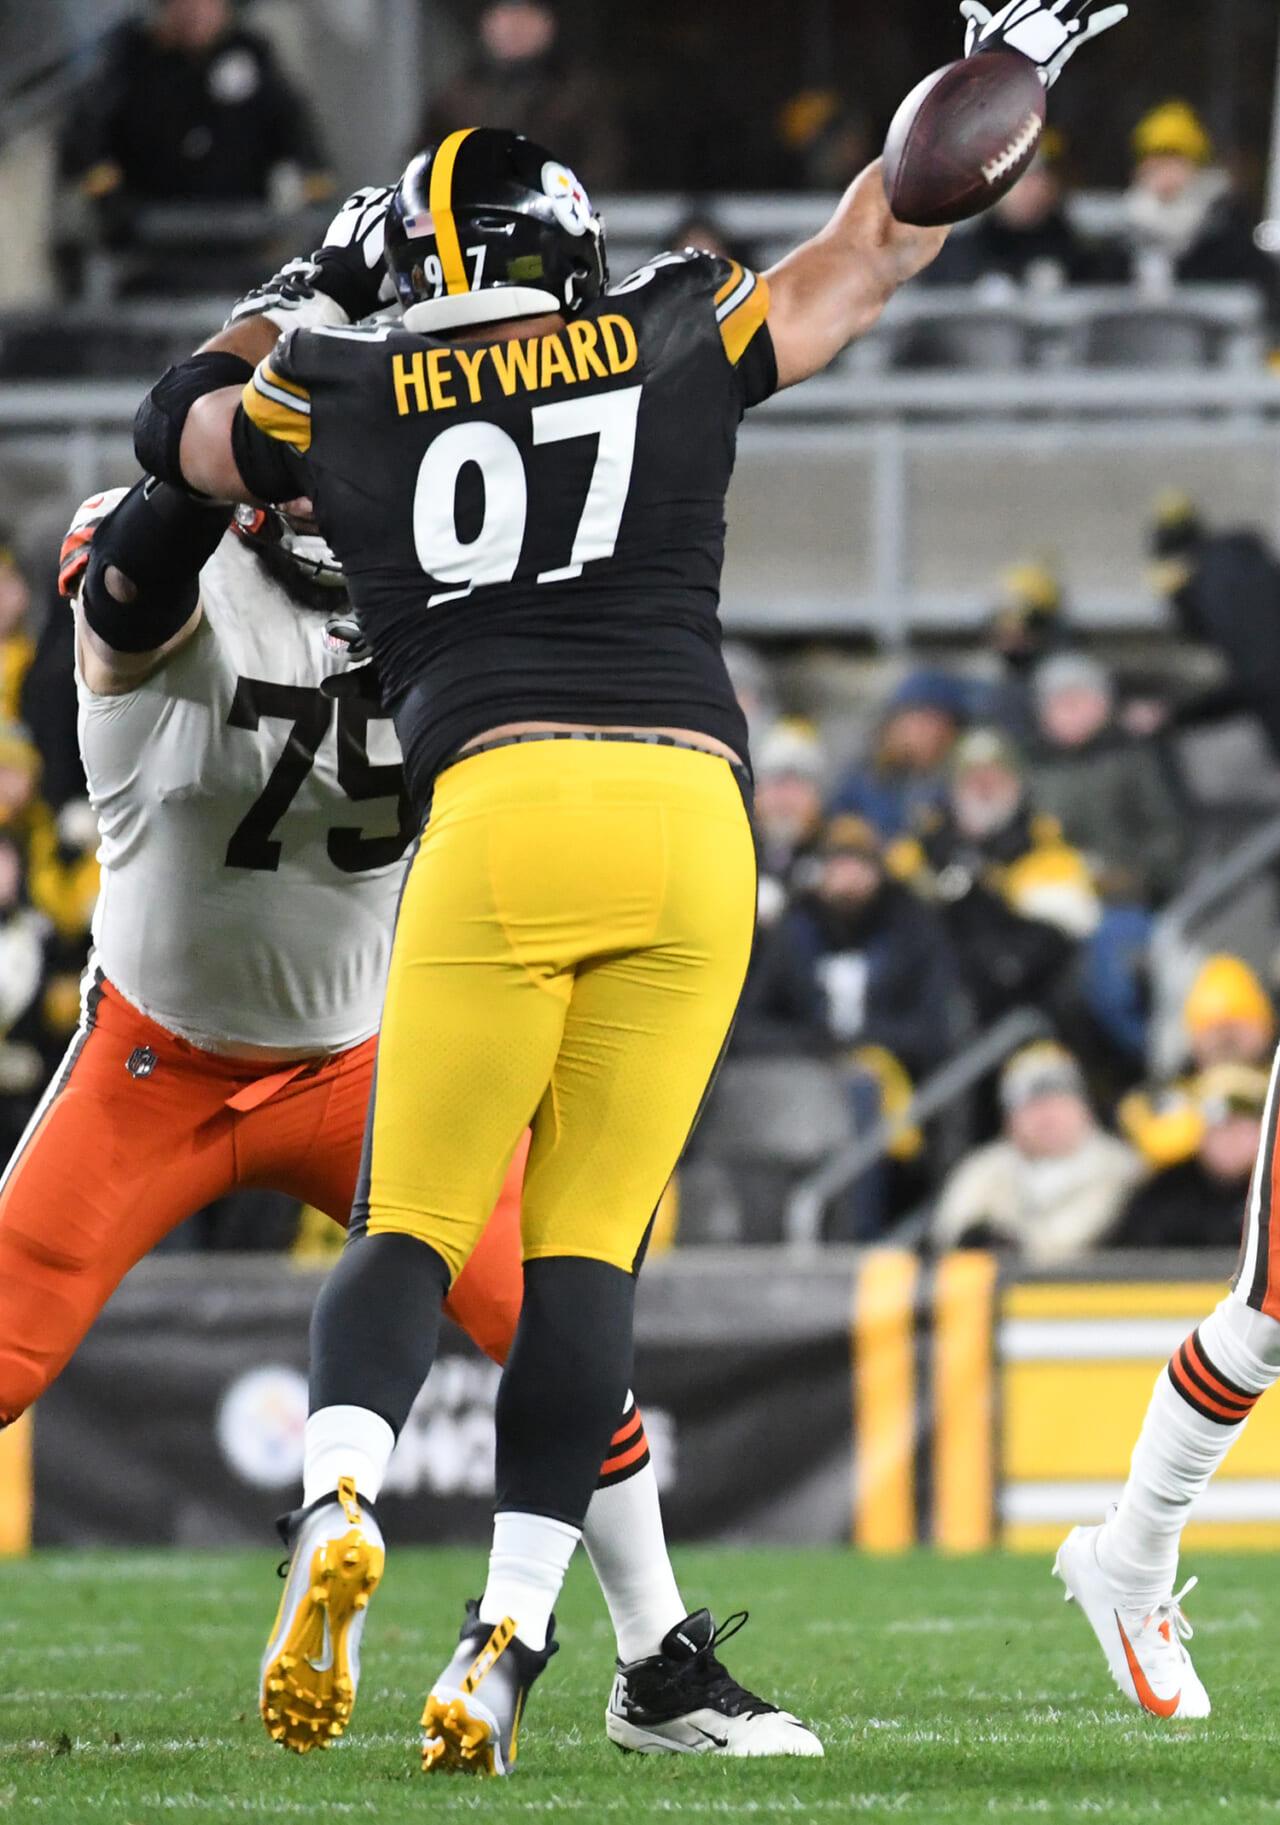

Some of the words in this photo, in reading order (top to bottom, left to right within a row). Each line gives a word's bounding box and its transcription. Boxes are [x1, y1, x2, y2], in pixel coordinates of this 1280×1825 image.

[392, 314, 638, 415] HEYWARD
[413, 385, 643, 608] 97
[225, 675, 414, 872] 75
